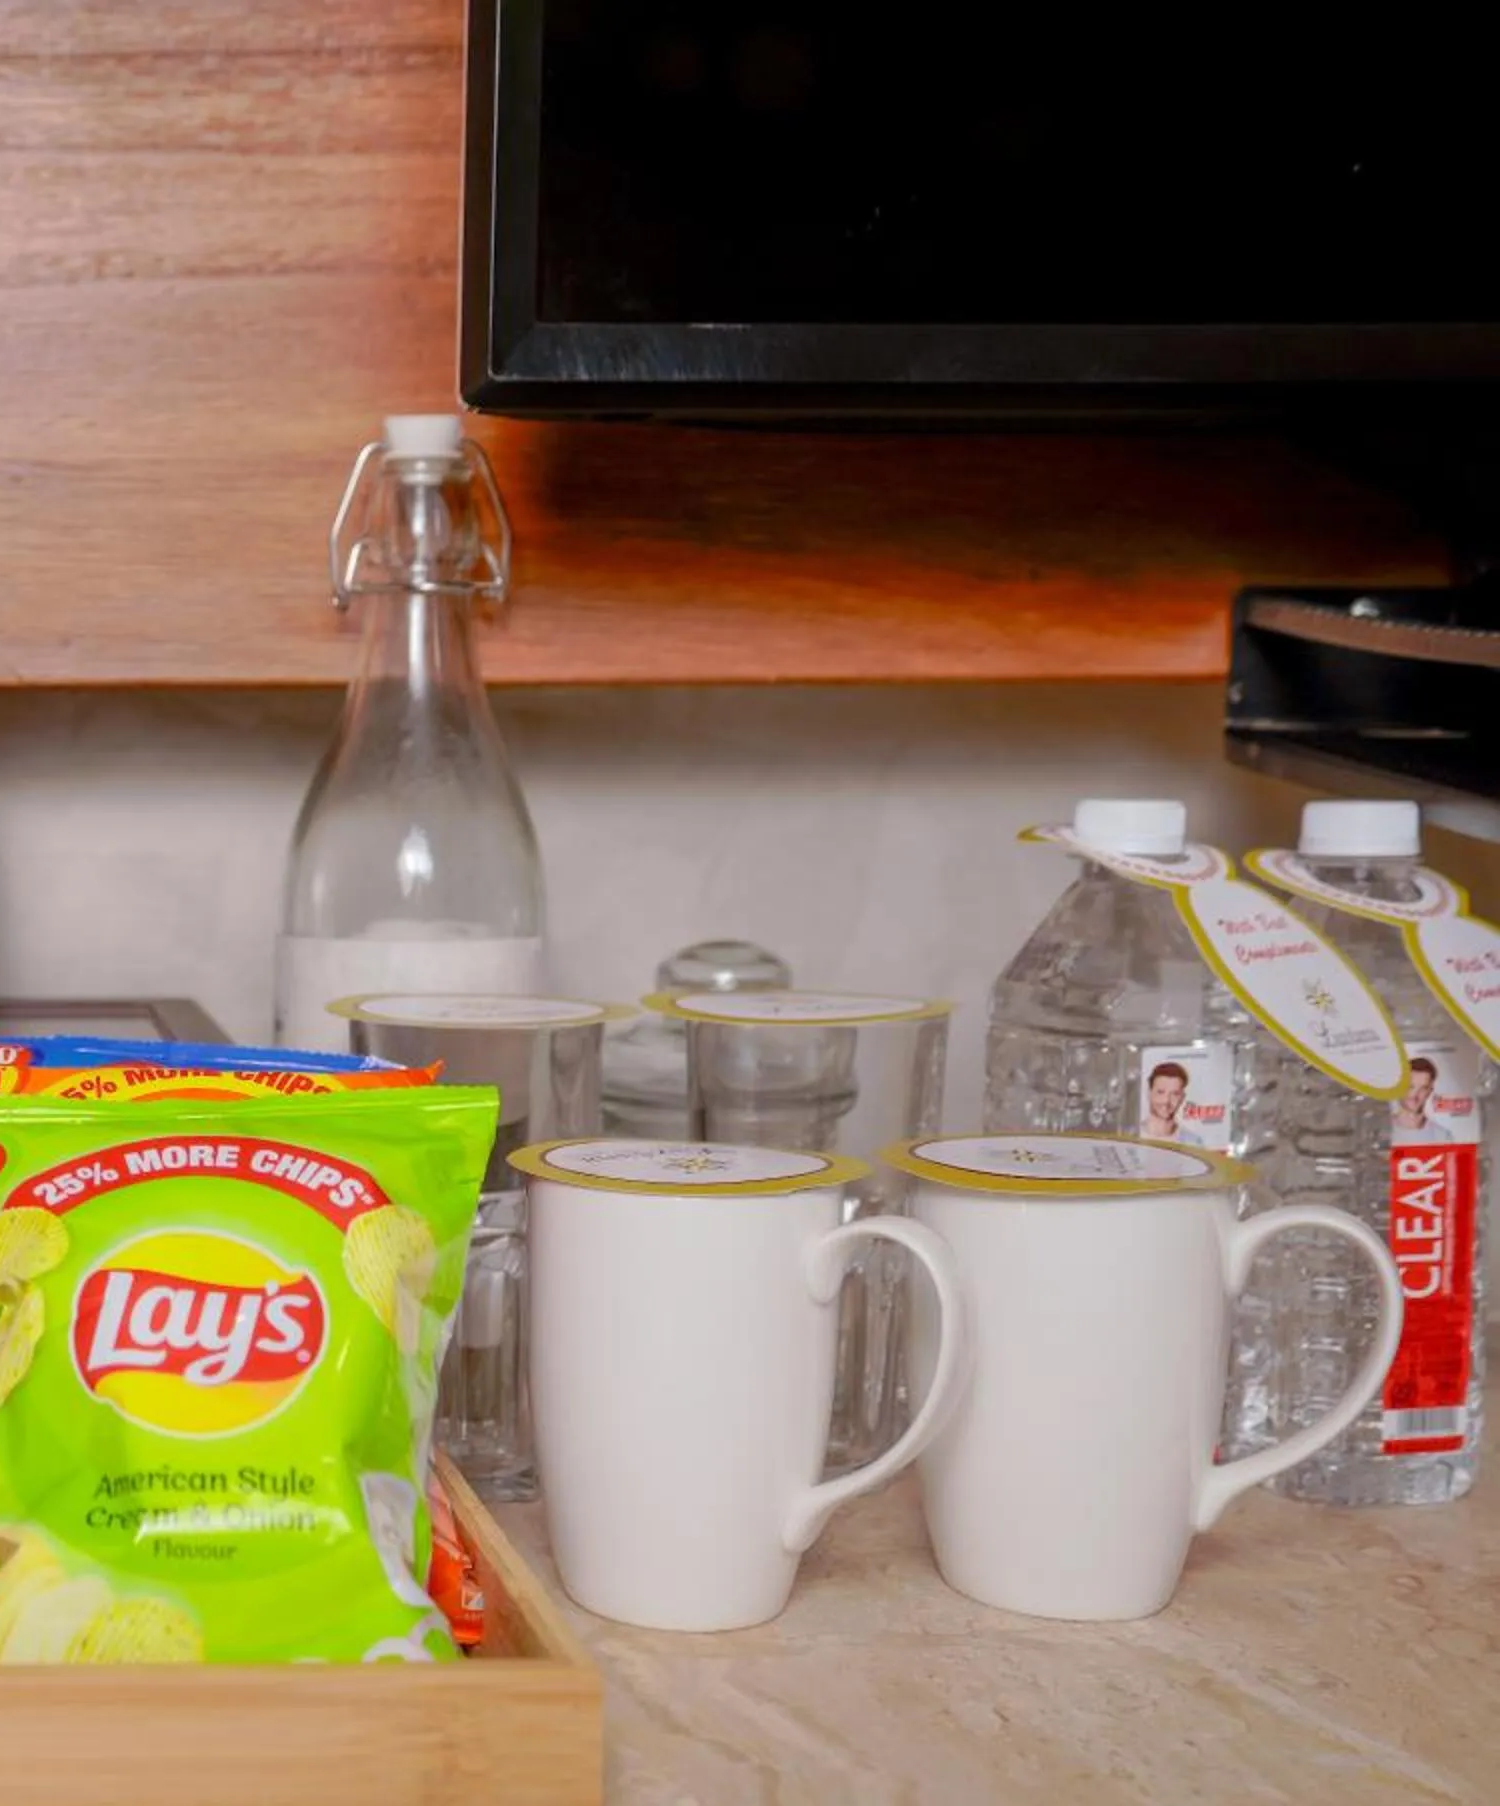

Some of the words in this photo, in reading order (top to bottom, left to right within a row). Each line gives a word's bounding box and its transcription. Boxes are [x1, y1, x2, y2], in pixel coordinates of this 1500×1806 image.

[33, 1162, 119, 1206] 25%
[123, 1145, 240, 1175] MORE
[1396, 1153, 1445, 1299] CLEAR
[88, 1272, 311, 1386] Lay's
[94, 1465, 228, 1498] American
[238, 1466, 316, 1497] Style
[152, 1538, 239, 1561] Flavour
